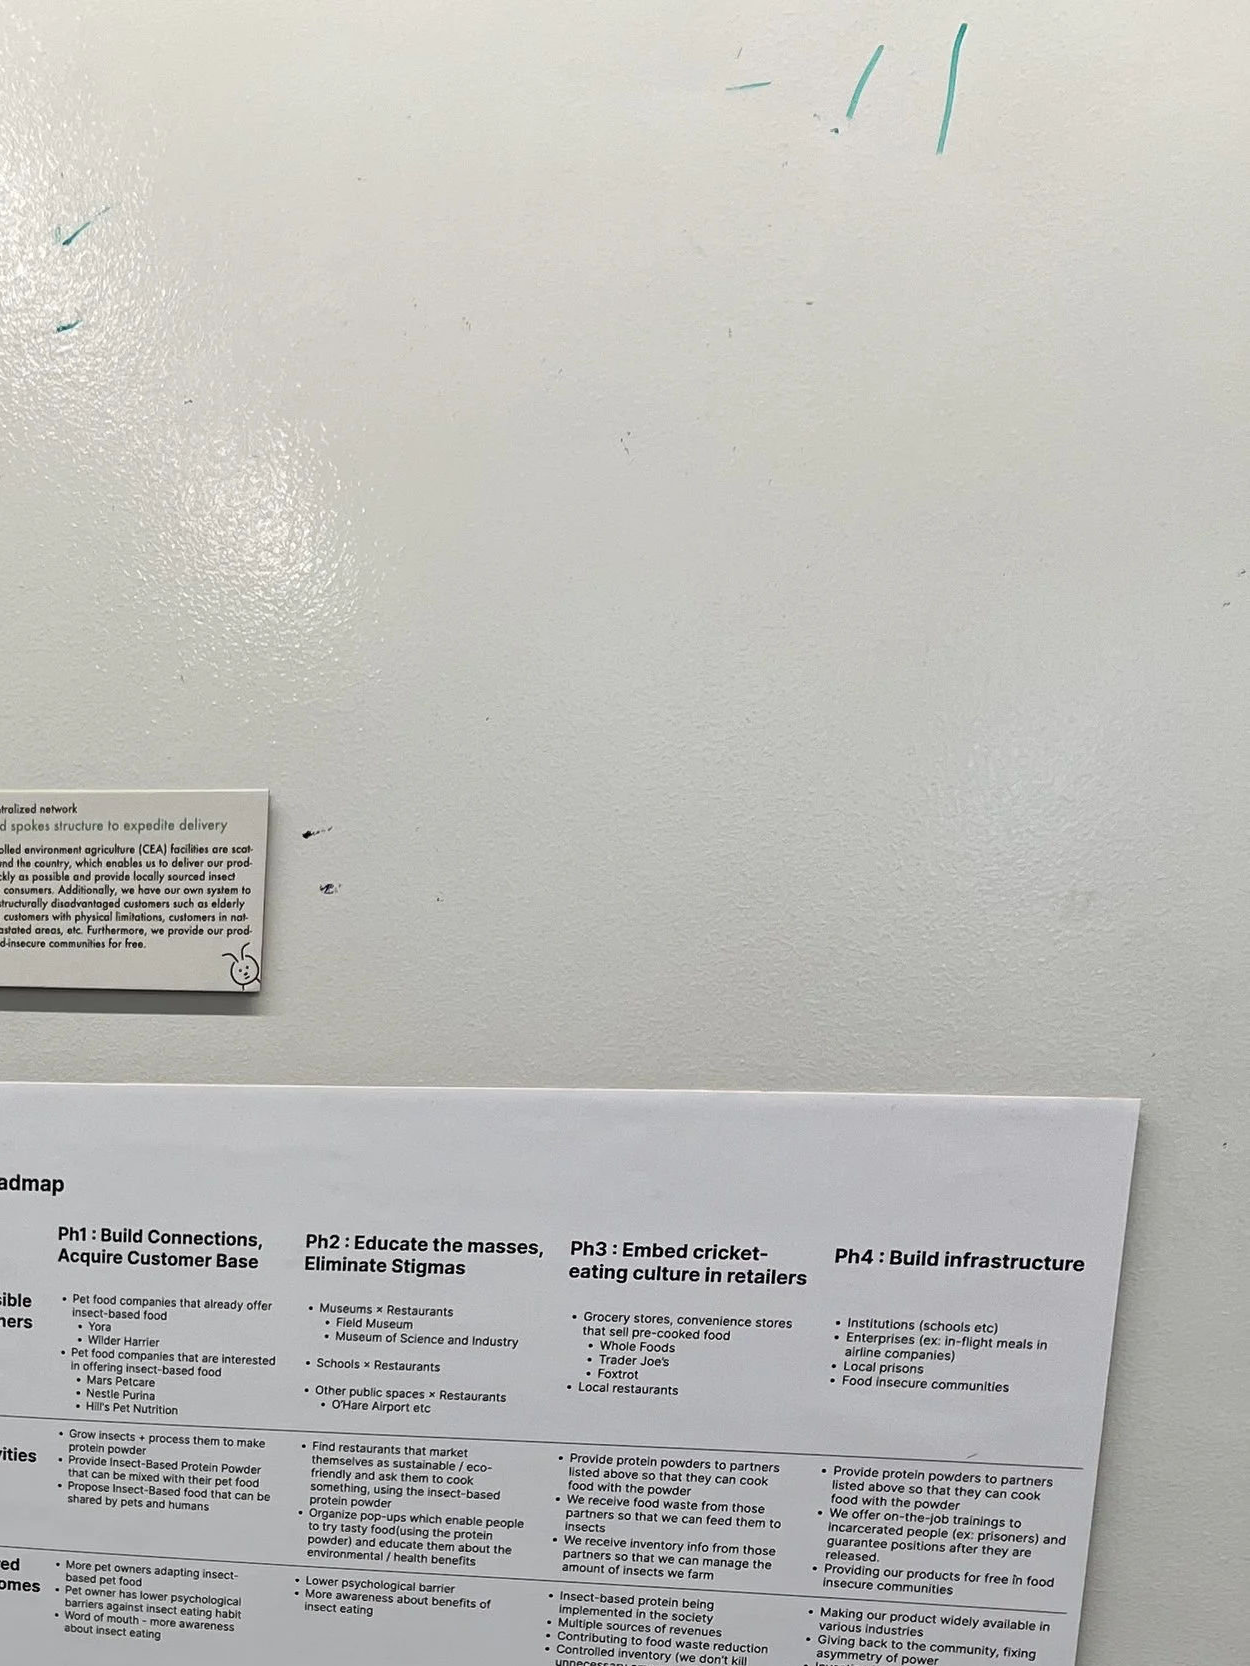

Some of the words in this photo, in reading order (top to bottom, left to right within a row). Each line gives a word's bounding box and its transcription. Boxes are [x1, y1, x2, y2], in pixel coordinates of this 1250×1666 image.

[40, 802, 77, 814] network
[11, 818, 50, 834] spokes
[54, 820, 103, 831] structure
[108, 820, 119, 831] to
[124, 817, 174, 834] expedite
[179, 817, 227, 834] delivery
[49, 939, 105, 948] communities
[109, 938, 122, 948] for
[125, 938, 146, 948] free.
[59, 1226, 86, 1241] Ph1
[101, 1227, 142, 1243] Build
[148, 1230, 262, 1250] Connections,
[306, 1234, 339, 1249] Ph2
[355, 1235, 428, 1251] Educate
[433, 1238, 462, 1252] the
[468, 1242, 543, 1258] masses,
[571, 1240, 607, 1256] Ph3
[623, 1242, 688, 1258] Embed
[693, 1244, 768, 1261] cricket-
[58, 1248, 123, 1266] Acquire
[128, 1250, 212, 1267] Customer
[217, 1253, 258, 1269] Base
[835, 1248, 873, 1265] Ph4
[890, 1250, 939, 1266] Build
[944, 1251, 1084, 1271] infrastructure
[305, 1256, 386, 1272] Eliminate
[392, 1259, 465, 1277] Stigmas
[569, 1264, 628, 1283] eating
[633, 1266, 700, 1281] culture
[705, 1266, 721, 1283] in
[727, 1269, 807, 1285] retailers
[88, 1321, 111, 1332] Yora
[336, 1317, 362, 1328] Field
[366, 1318, 413, 1329] Museum
[88, 1335, 121, 1345] Wilder
[124, 1337, 160, 1347] Harrier
[600, 1341, 636, 1352] Whole
[640, 1342, 675, 1352] Foods
[599, 1354, 637, 1365] Trader
[640, 1356, 669, 1366] Joe's
[844, 1361, 876, 1372] Local
[879, 1363, 923, 1374] prisons
[598, 1368, 638, 1380] Foxtrot
[87, 1375, 112, 1385] Mars
[116, 1377, 155, 1387] Petcare
[579, 1382, 609, 1393] Local
[613, 1384, 678, 1395] restaurants
[372, 1401, 409, 1413] Airport
[413, 1403, 431, 1413] etc
